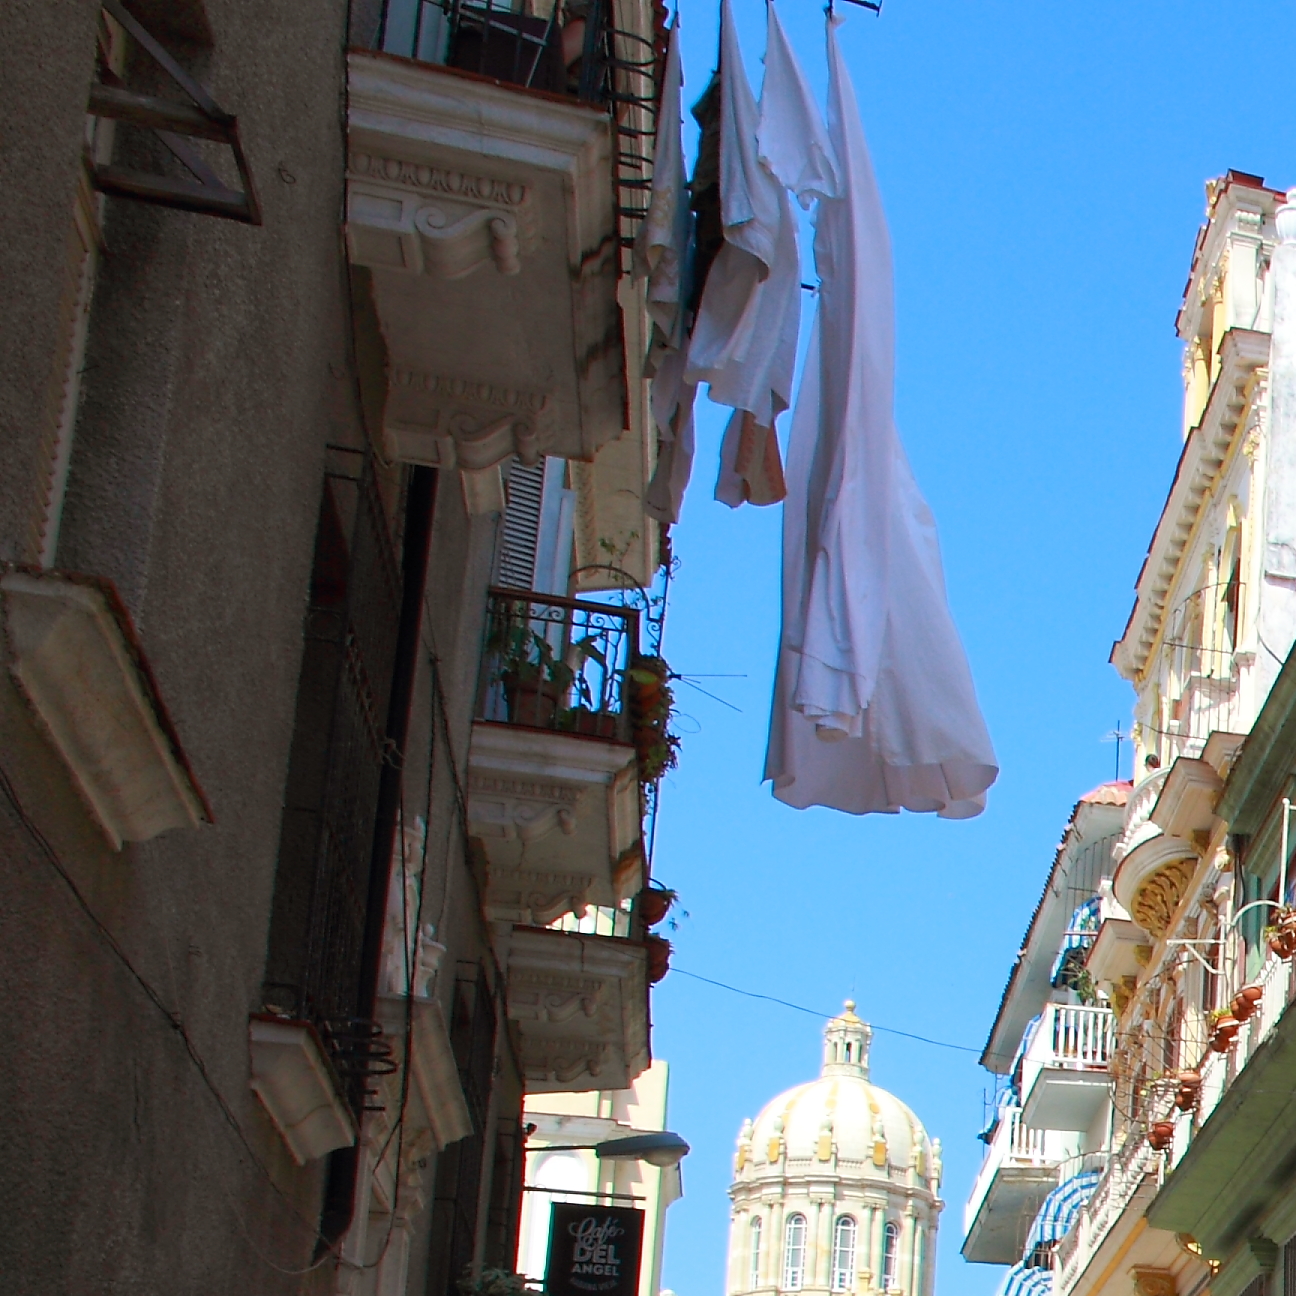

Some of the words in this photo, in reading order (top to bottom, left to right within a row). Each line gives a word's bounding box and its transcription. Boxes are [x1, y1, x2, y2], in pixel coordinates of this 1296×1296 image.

[568, 1217, 625, 1250] Café
[573, 1242, 620, 1264] DEL
[571, 1263, 619, 1276] ANGEL
